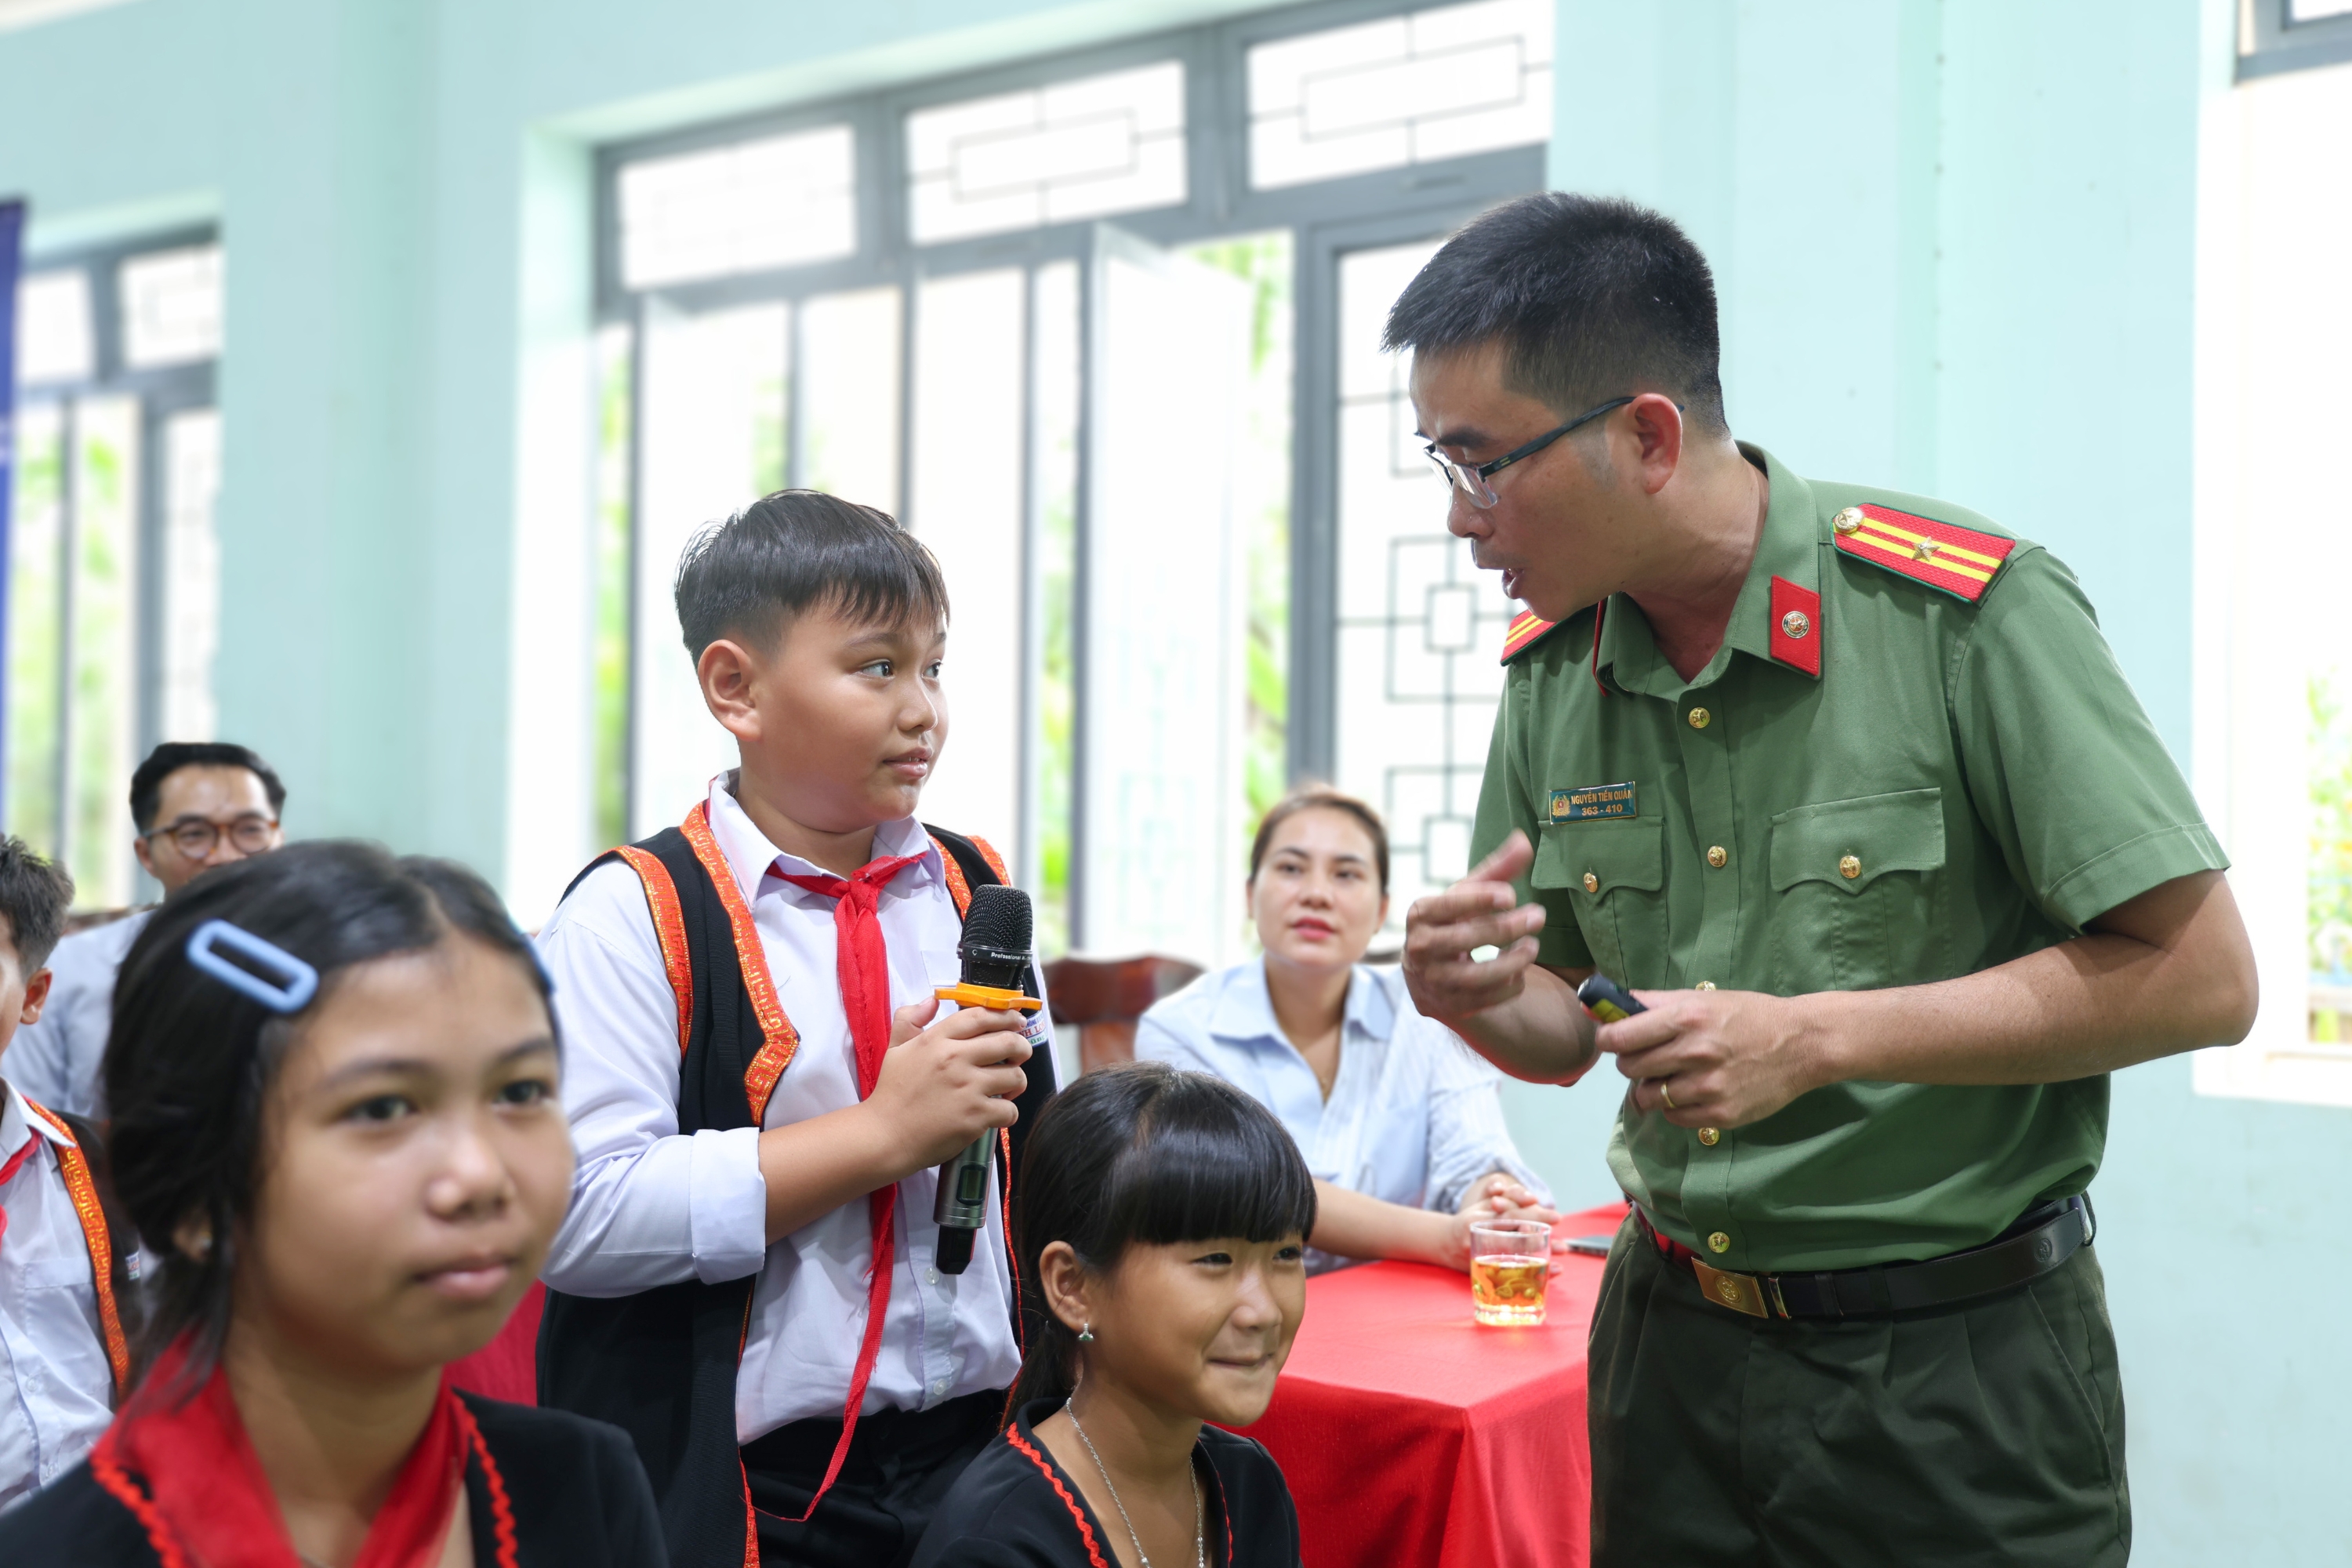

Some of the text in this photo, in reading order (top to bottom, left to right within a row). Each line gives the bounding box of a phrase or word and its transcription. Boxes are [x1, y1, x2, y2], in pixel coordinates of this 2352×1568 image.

[1571, 789, 1597, 804] NGUYỄN
[1598, 788, 1613, 802] TIẾN
[1582, 806, 1599, 816] 363
[1606, 804, 1623, 813] 410
[991, 952, 1021, 960] Professional
